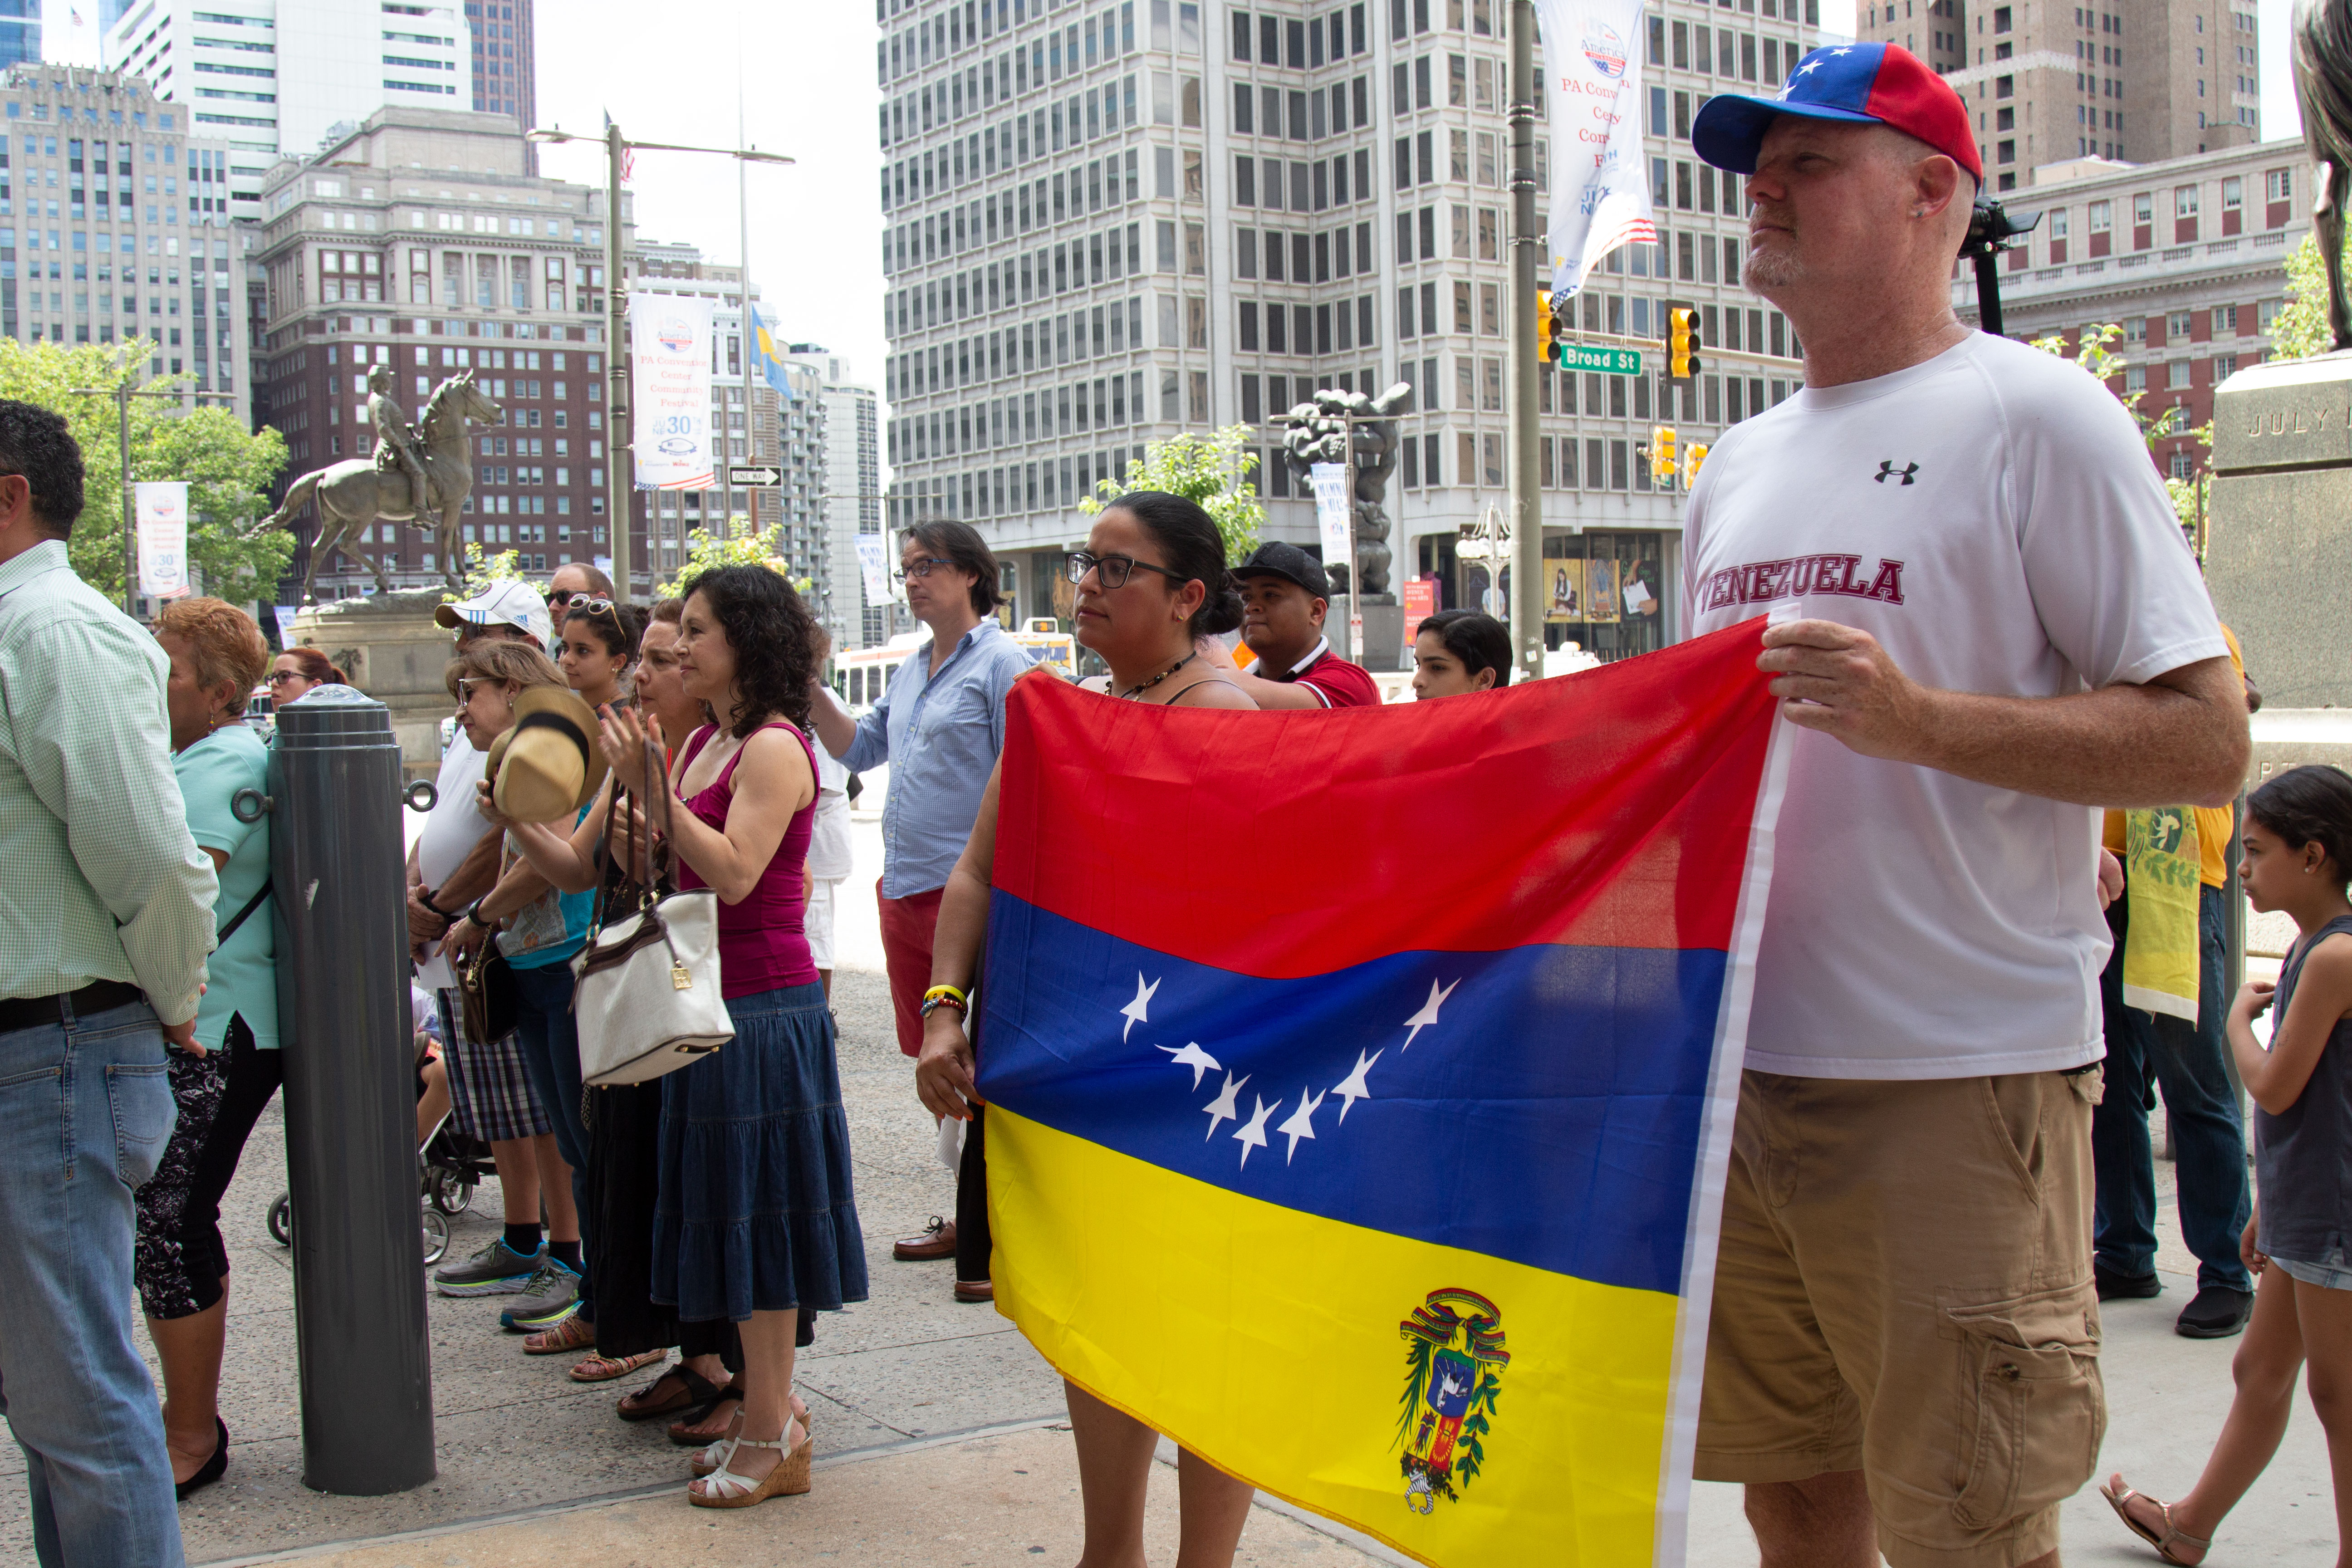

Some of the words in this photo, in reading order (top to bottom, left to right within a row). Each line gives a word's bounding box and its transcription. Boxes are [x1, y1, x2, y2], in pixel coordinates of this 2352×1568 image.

[1581, 39, 1625, 59] America
[1561, 78, 1582, 93] PA
[1567, 348, 1611, 368] Broad
[1617, 351, 1635, 370] St
[661, 371, 692, 380] Center
[650, 384, 704, 395] Community
[661, 399, 699, 407] Festival
[667, 416, 691, 434] 30
[2248, 408, 2329, 437] JULY
[1318, 482, 1347, 497] MAMMA
[158, 554, 173, 566] 30
[1700, 553, 1905, 616] VENEZUELA
[514, 617, 529, 627] adidas
